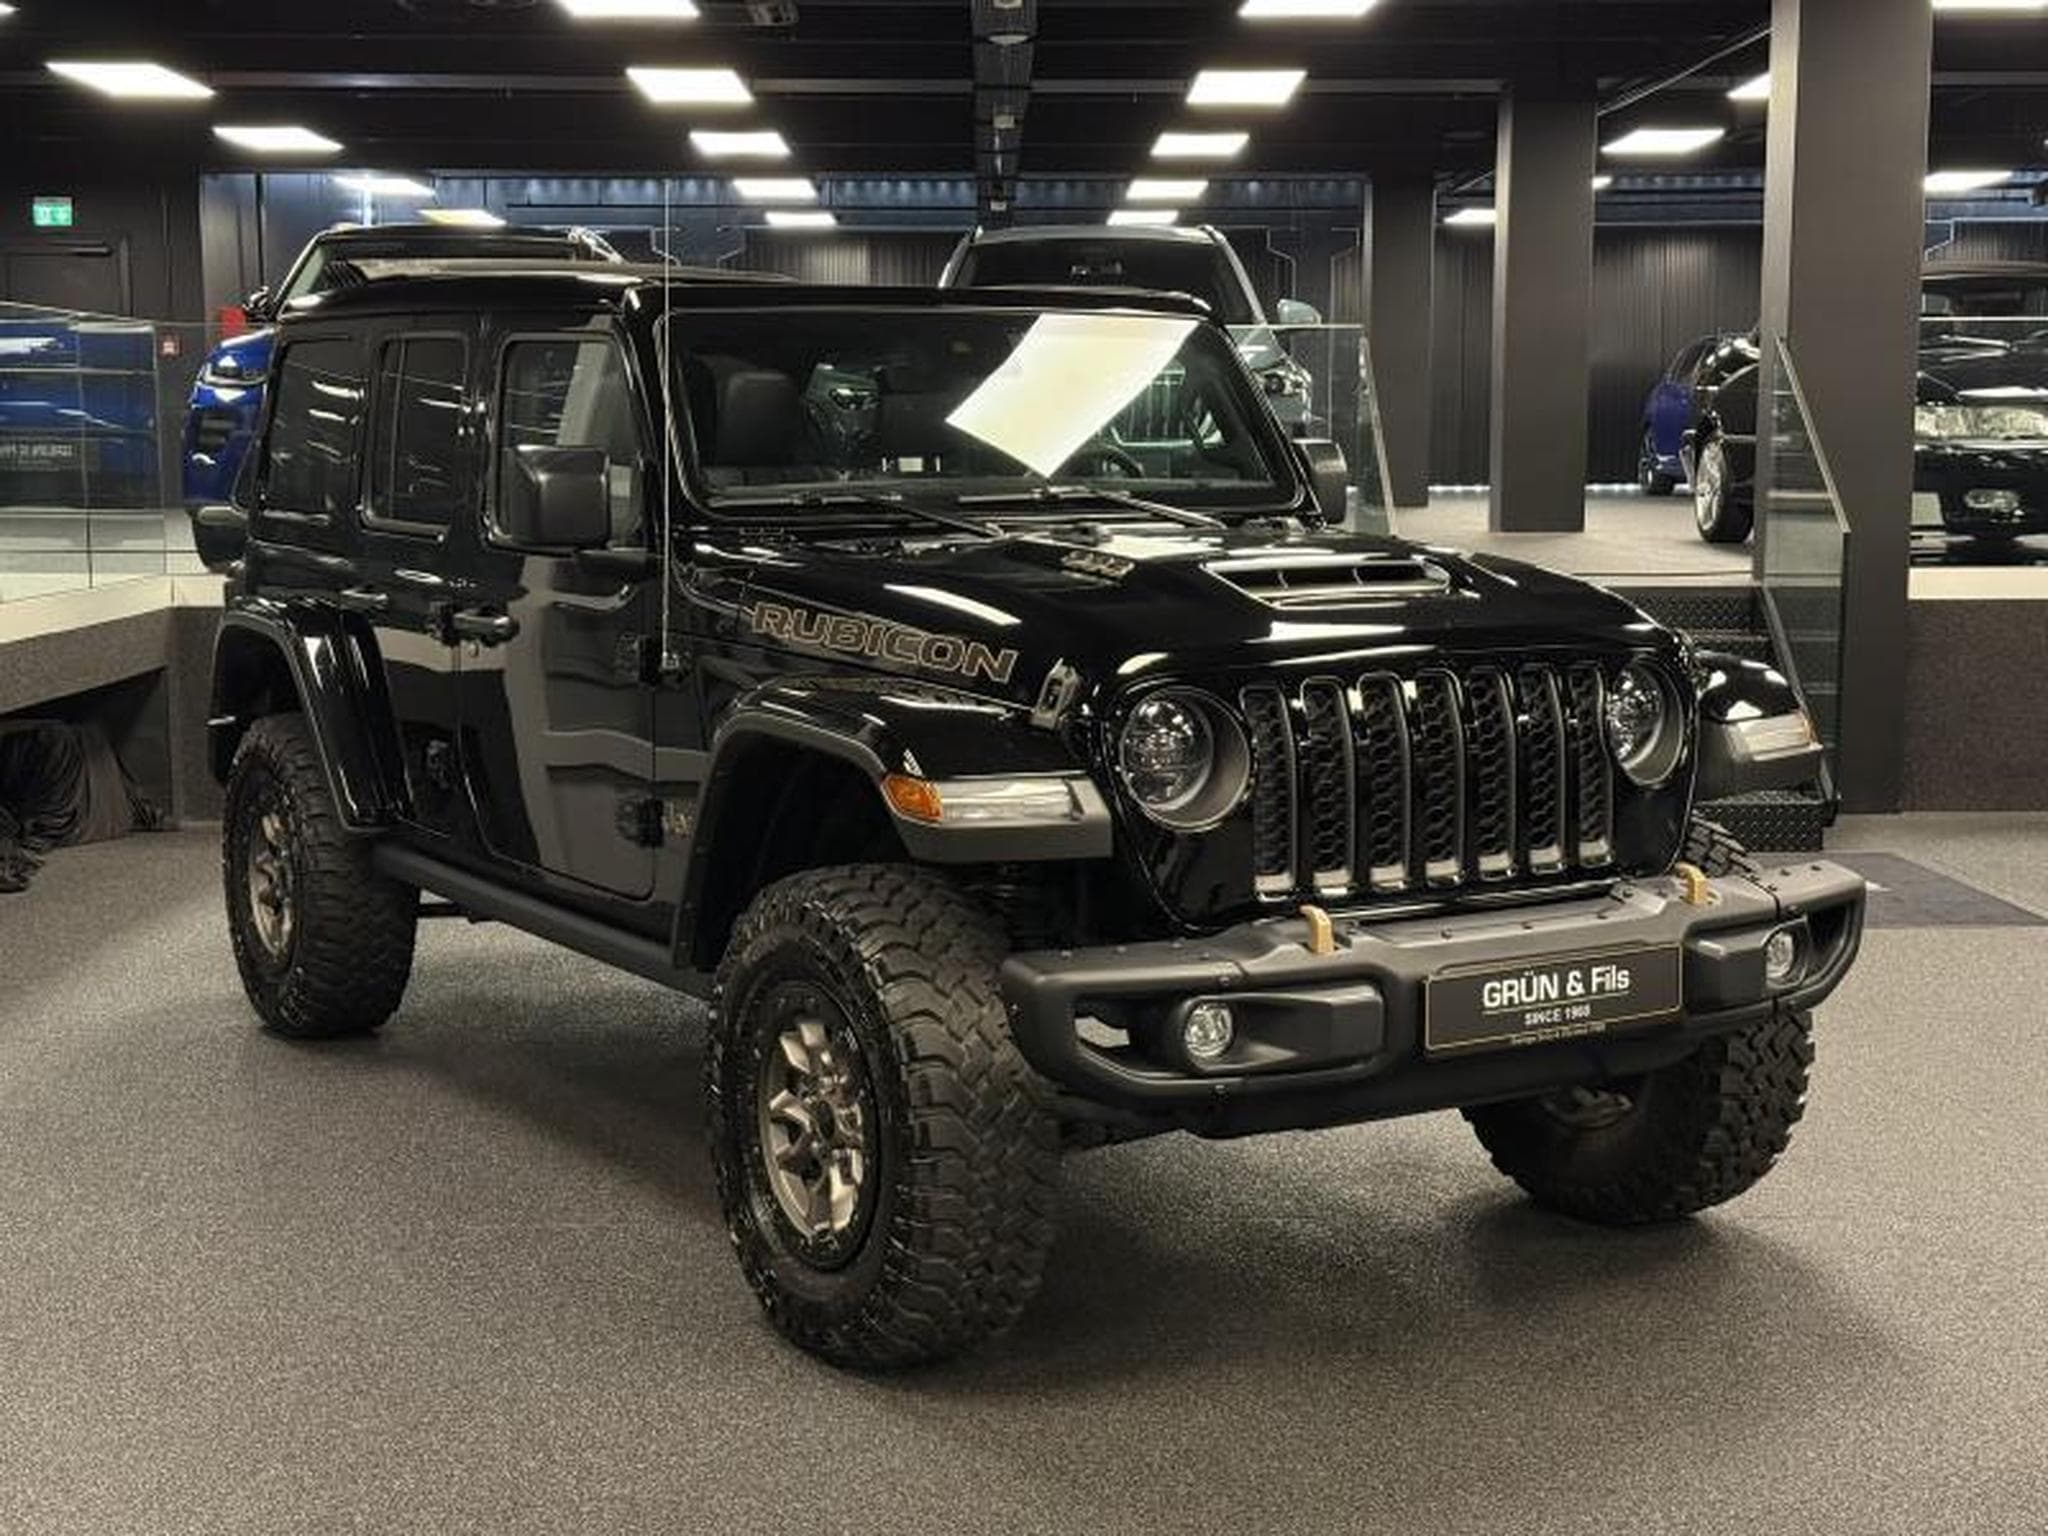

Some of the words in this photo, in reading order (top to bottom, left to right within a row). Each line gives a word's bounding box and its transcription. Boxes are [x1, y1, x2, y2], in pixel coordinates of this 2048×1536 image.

[753, 601, 1018, 684] RUBICON
[1483, 969, 1559, 1008] GRÜN
[1566, 969, 1586, 997] &
[1591, 964, 1630, 994] Fils
[1524, 1007, 1562, 1026] SINCE
